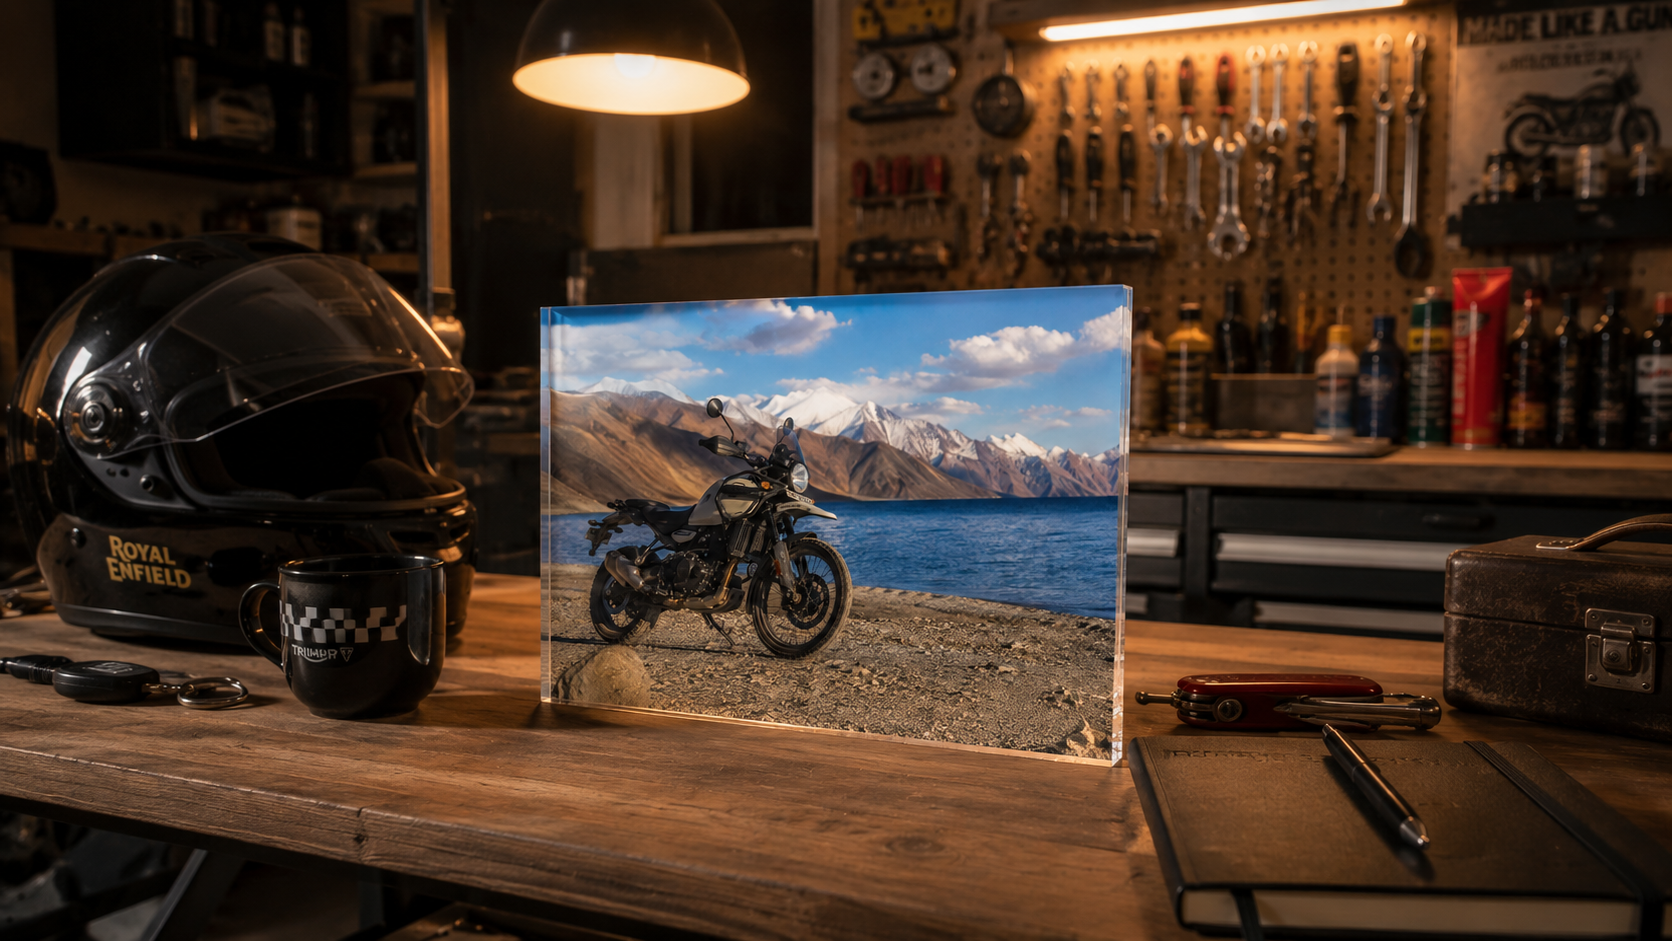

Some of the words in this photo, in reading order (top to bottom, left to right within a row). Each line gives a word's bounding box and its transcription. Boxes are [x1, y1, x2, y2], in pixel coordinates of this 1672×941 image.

[1461, 14, 1537, 44] MADE
[1541, 11, 1594, 38] LIKE
[1600, 8, 1620, 34] A
[108, 535, 176, 566] ROYAL
[105, 557, 192, 589] ENFIELD
